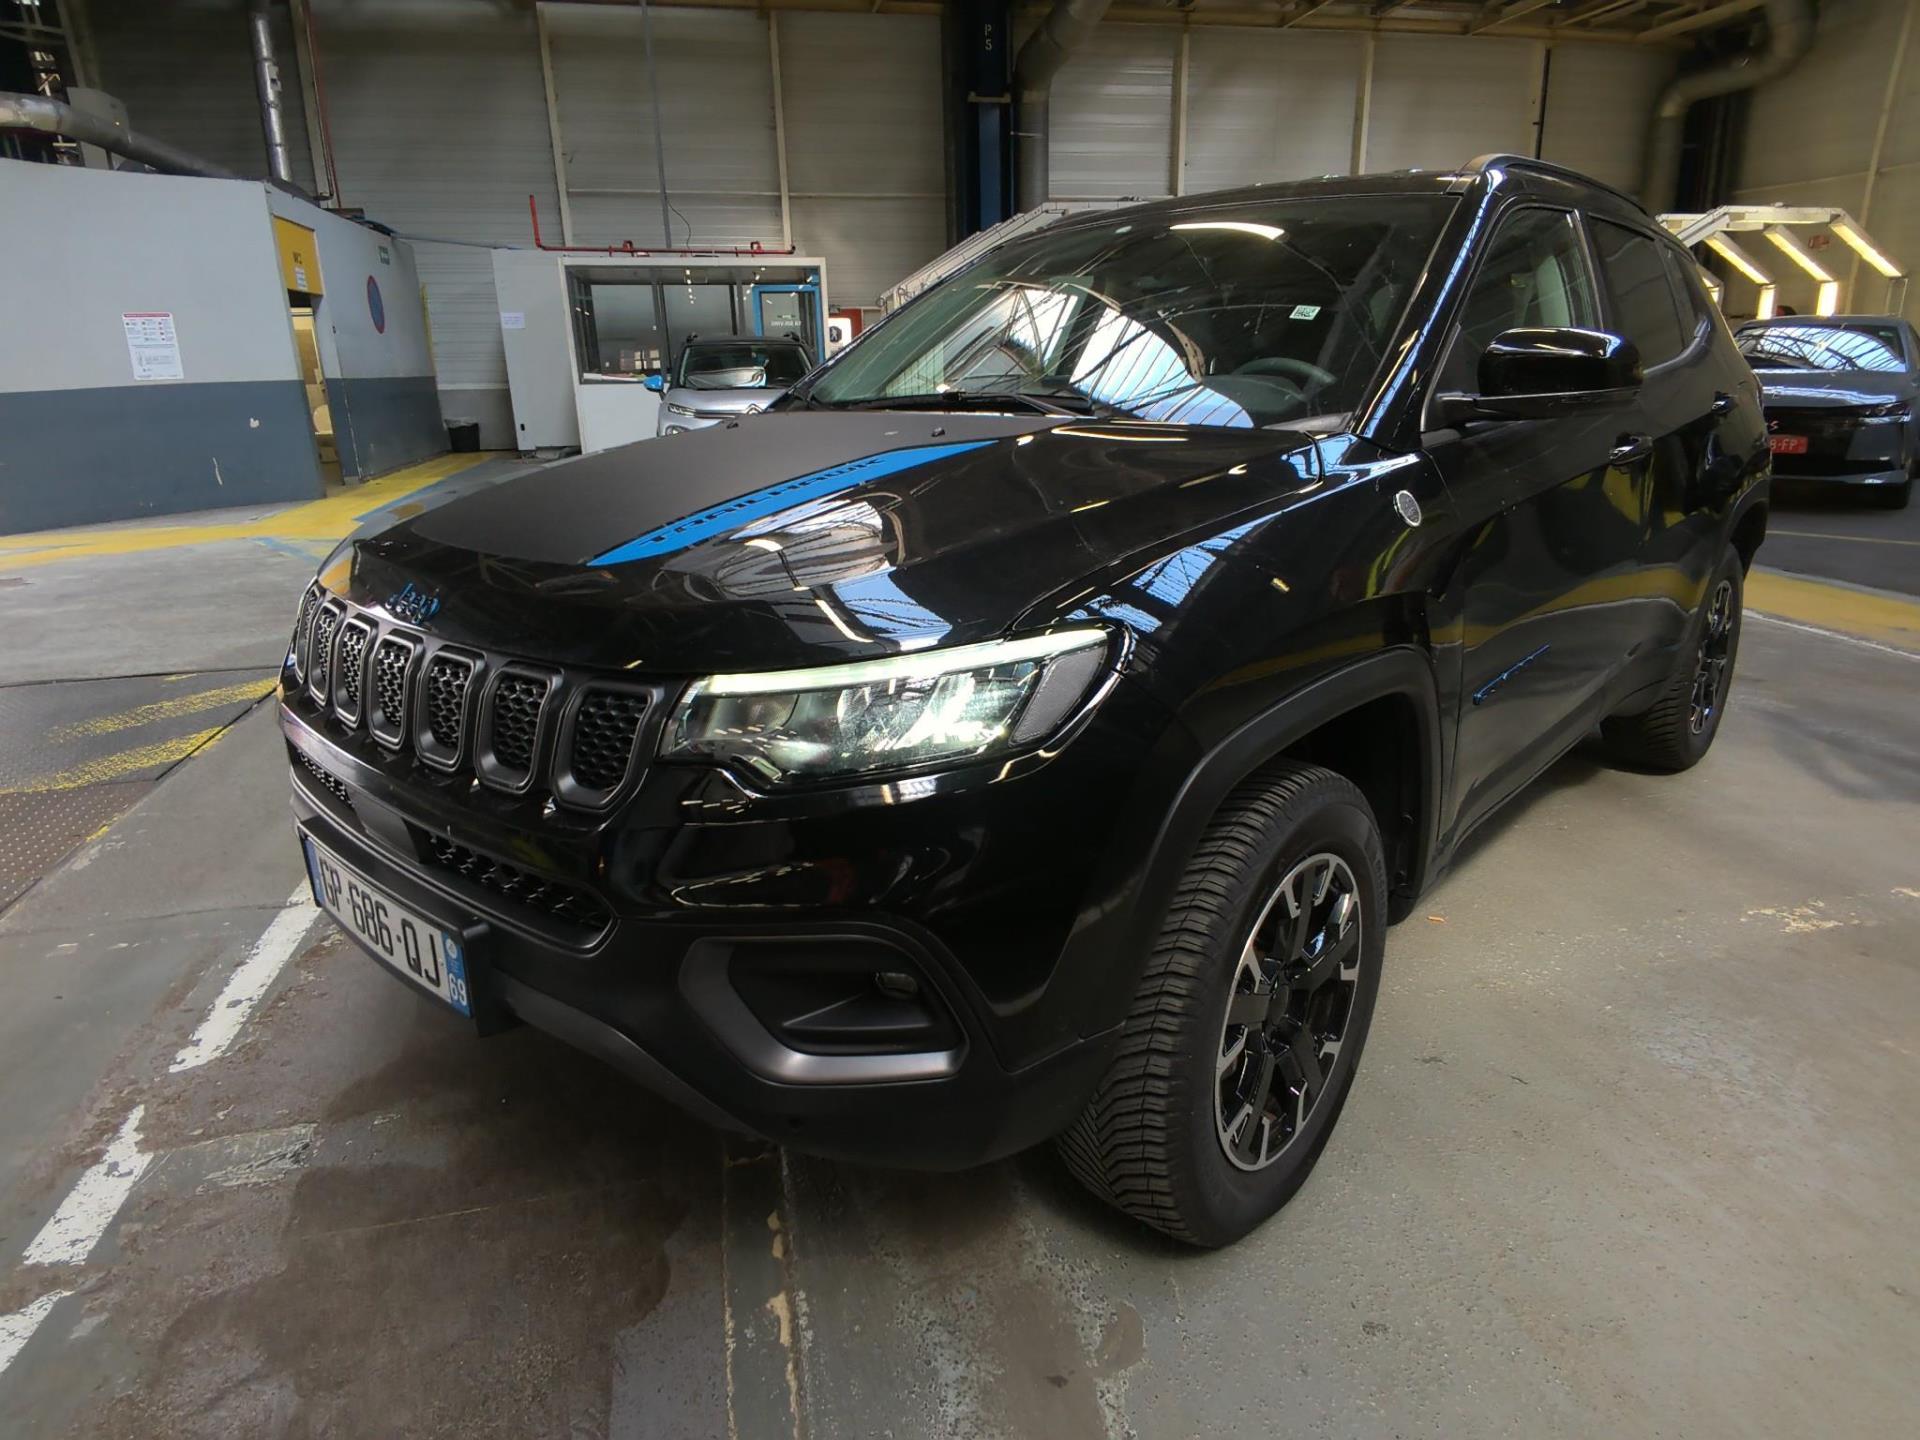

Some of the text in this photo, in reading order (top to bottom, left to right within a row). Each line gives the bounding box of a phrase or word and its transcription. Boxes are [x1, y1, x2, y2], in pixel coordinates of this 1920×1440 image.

[638, 457, 886, 543] TRAILHAWK
[384, 582, 440, 625] Jeep
[448, 972, 467, 1007] 69
